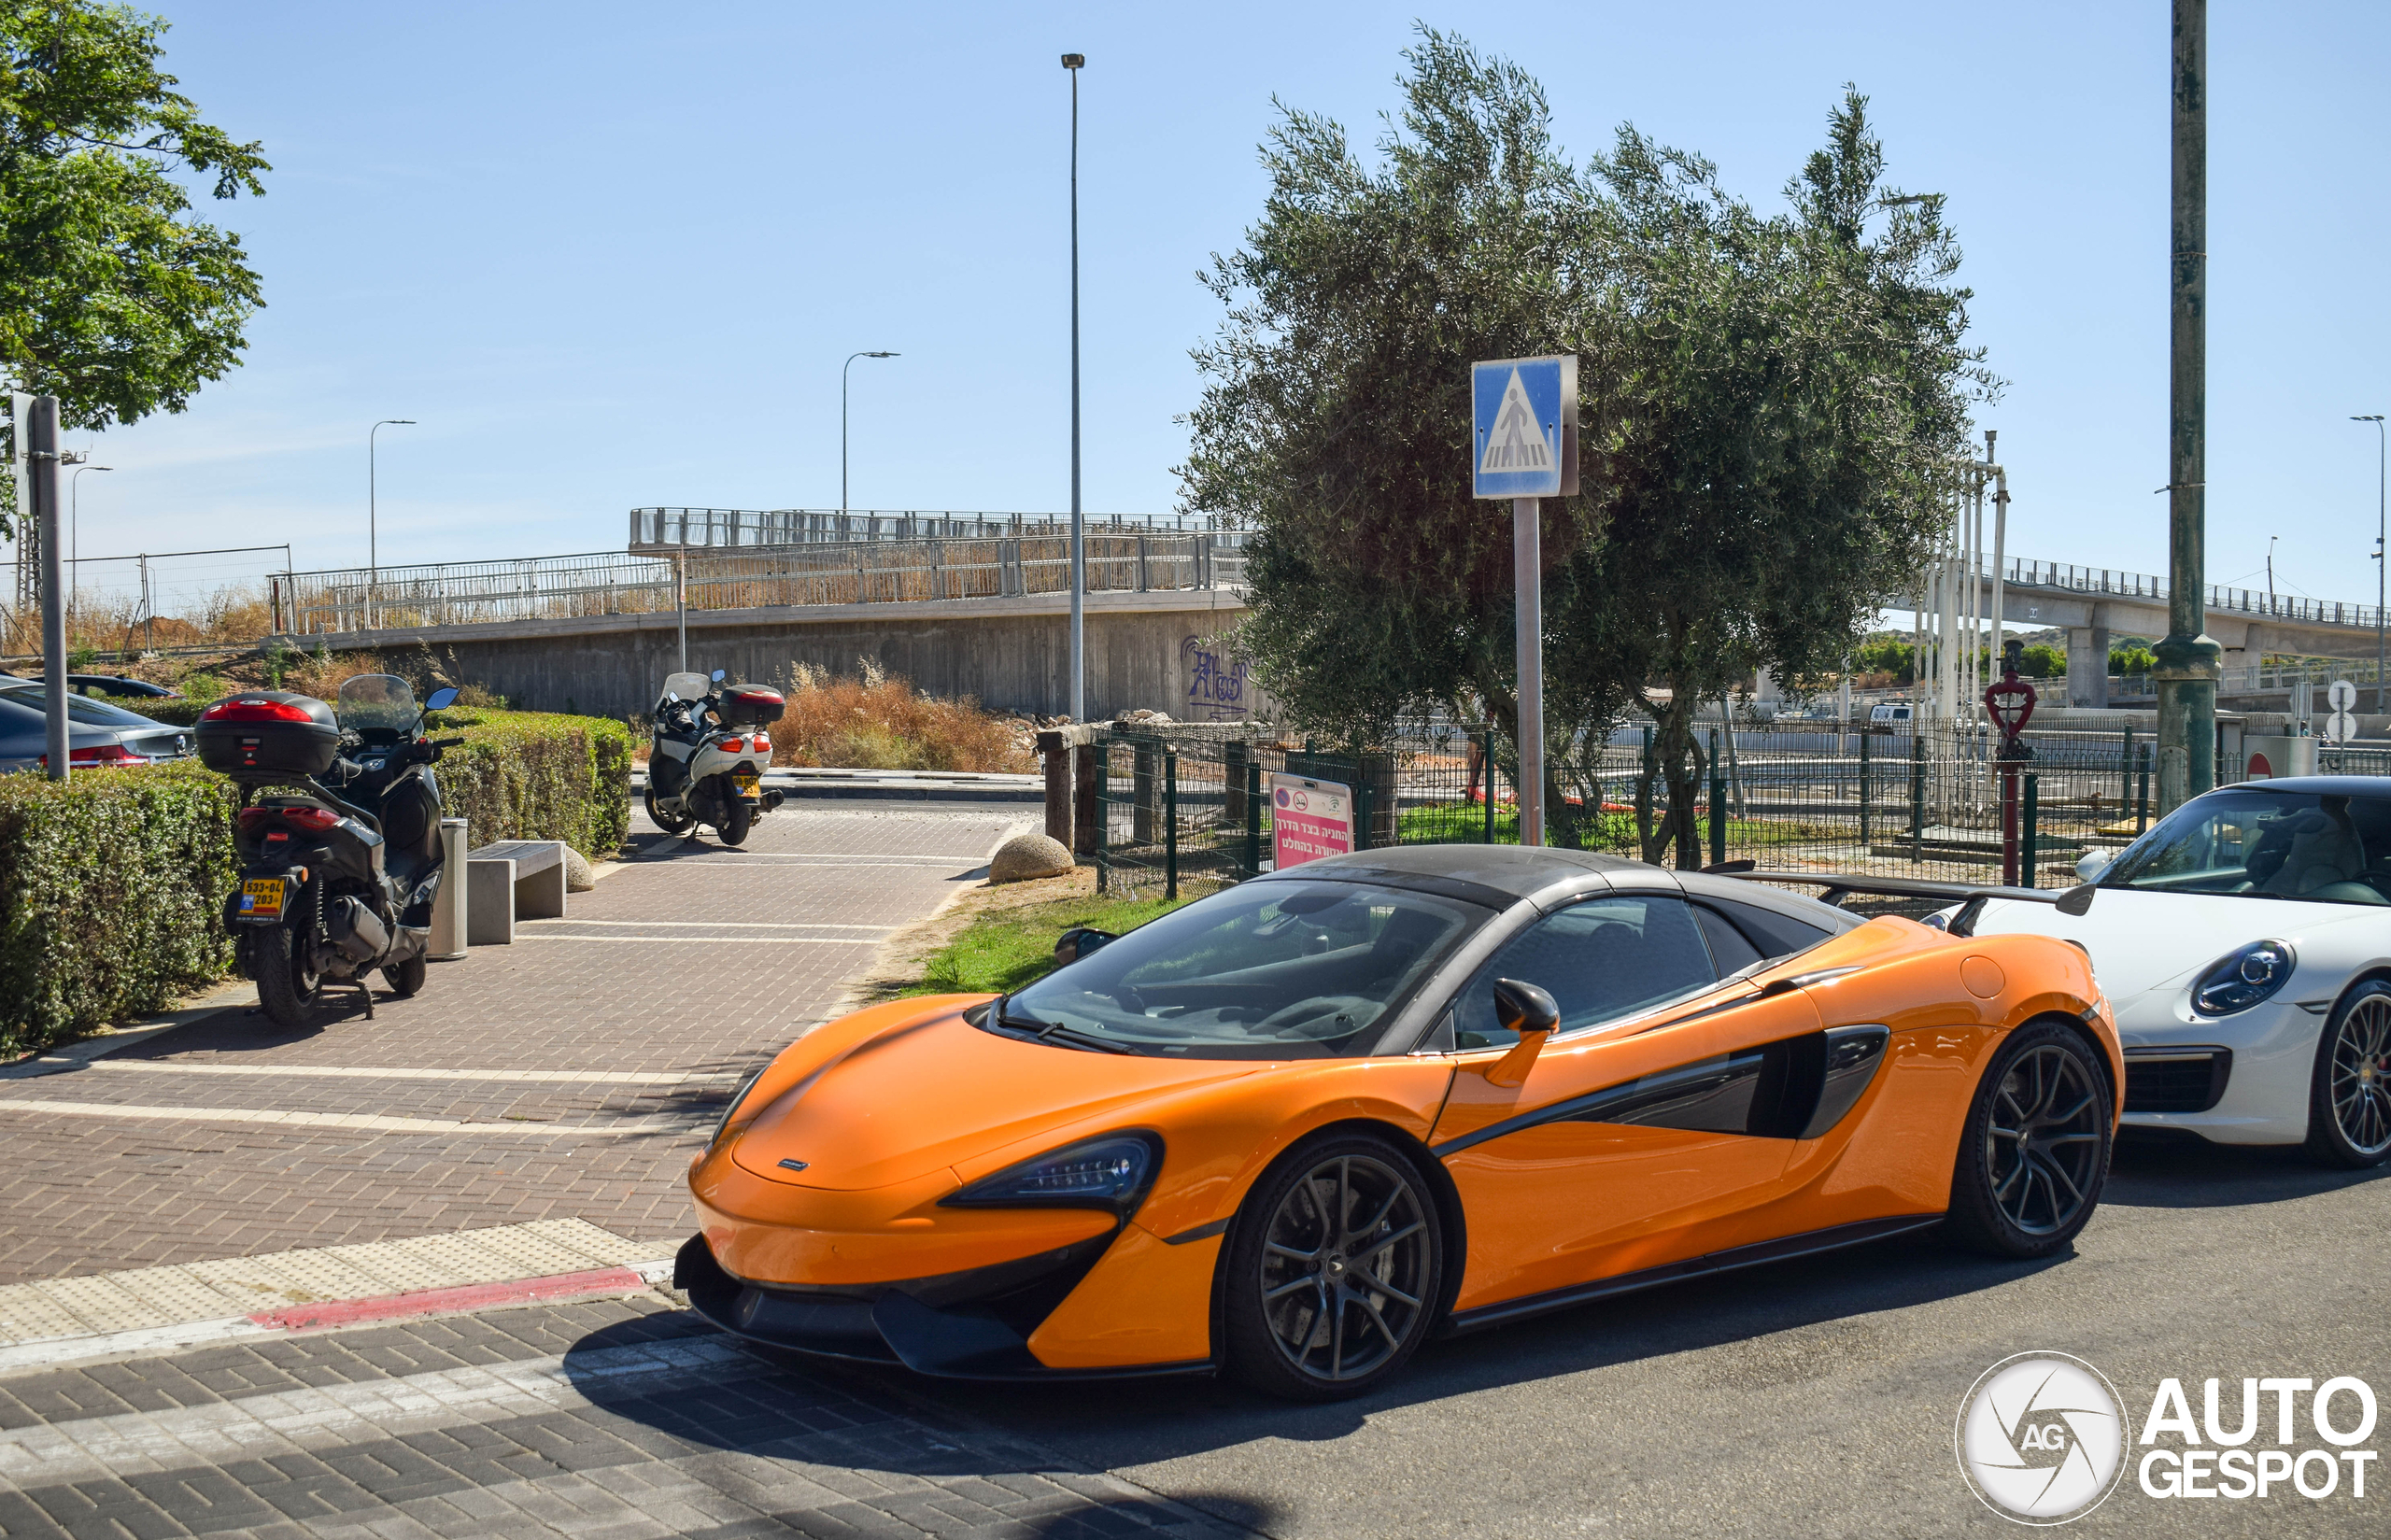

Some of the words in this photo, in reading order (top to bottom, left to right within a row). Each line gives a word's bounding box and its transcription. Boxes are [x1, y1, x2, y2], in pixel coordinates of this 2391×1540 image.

[1276, 817, 1299, 831] הדרך
[1300, 823, 1320, 836] בצד
[1322, 827, 1348, 842] החניה
[1281, 836, 1313, 854] בהחלט
[247, 883, 281, 893] 533-04
[255, 894, 274, 905] 203
